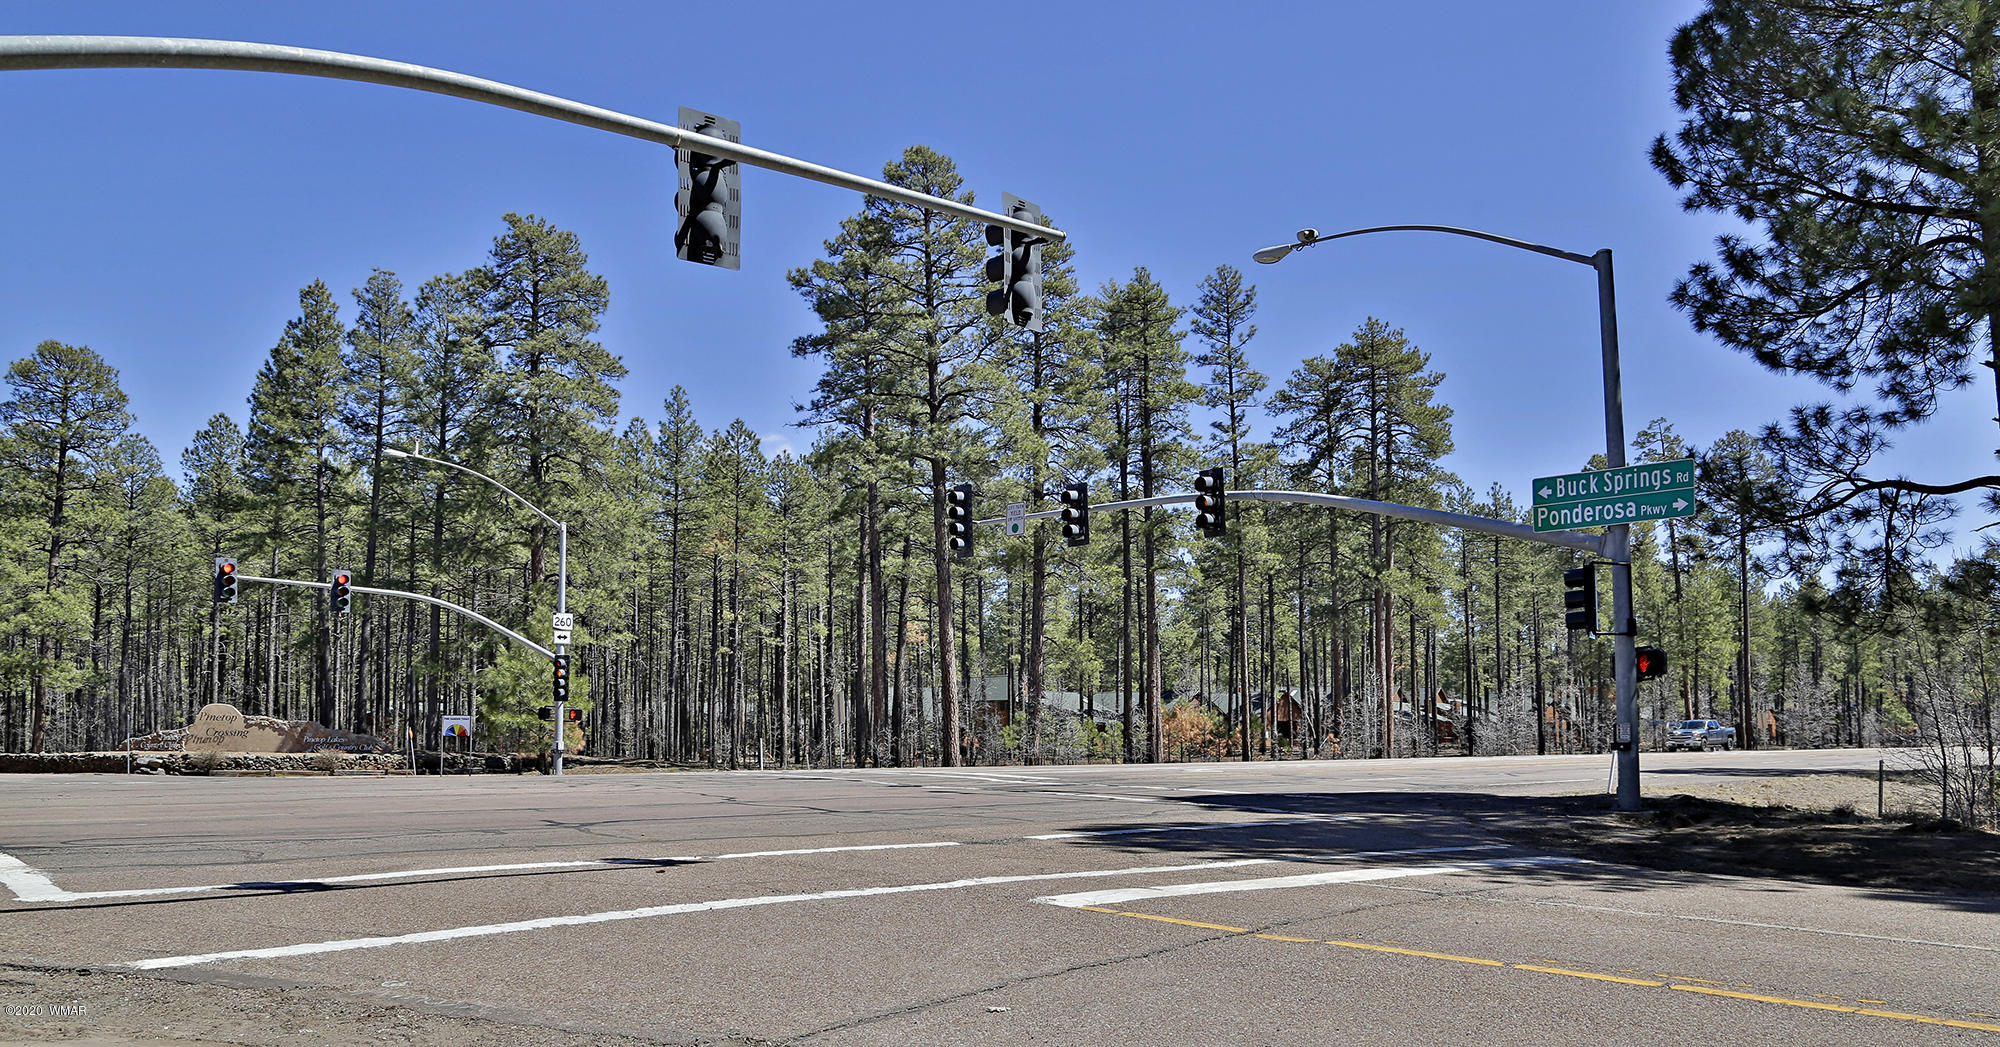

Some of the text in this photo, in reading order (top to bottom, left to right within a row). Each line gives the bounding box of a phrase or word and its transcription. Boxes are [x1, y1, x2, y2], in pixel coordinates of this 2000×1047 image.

[1556, 468, 1689, 498] Buck Springs Rd
[1537, 501, 1667, 527] Ponderosa Pkwy
[555, 616, 571, 627] 260
[199, 711, 238, 725] Pinetop
[205, 727, 249, 739] Crossing
